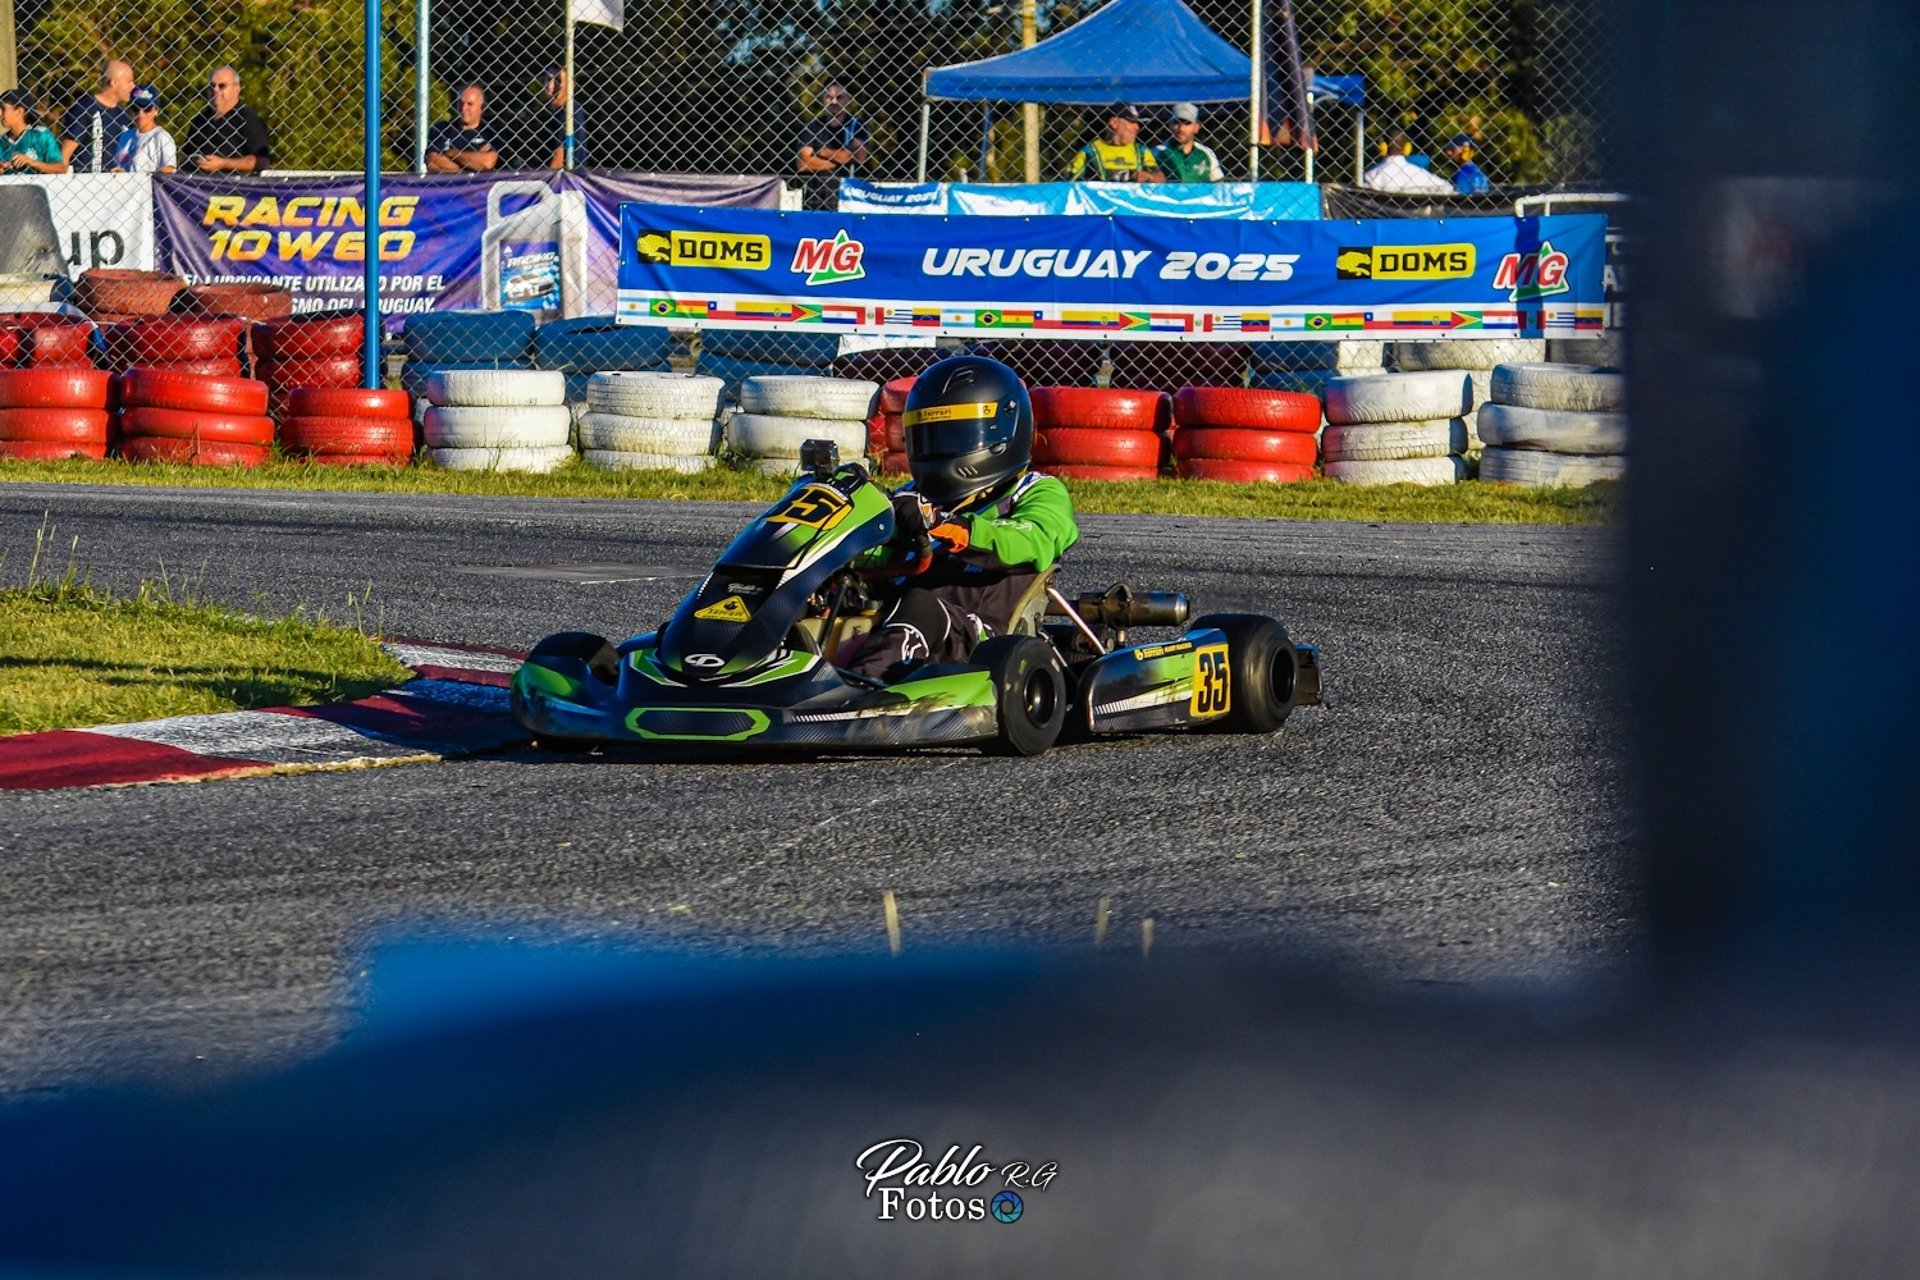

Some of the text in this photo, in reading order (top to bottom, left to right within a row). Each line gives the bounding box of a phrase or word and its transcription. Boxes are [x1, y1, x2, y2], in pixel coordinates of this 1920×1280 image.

[202, 195, 420, 227] RACING
[208, 230, 416, 261] 10W60
[678, 238, 763, 263] DOMS
[792, 239, 864, 273] MG
[1378, 250, 1468, 273] DOMS
[921, 247, 1301, 282] URUGUAY 2025
[1494, 252, 1567, 288] MG
[305, 275, 388, 292] UTILIZAO
[390, 275, 423, 292] POR
[426, 275, 446, 291] EL
[1198, 652, 1229, 713] 35
